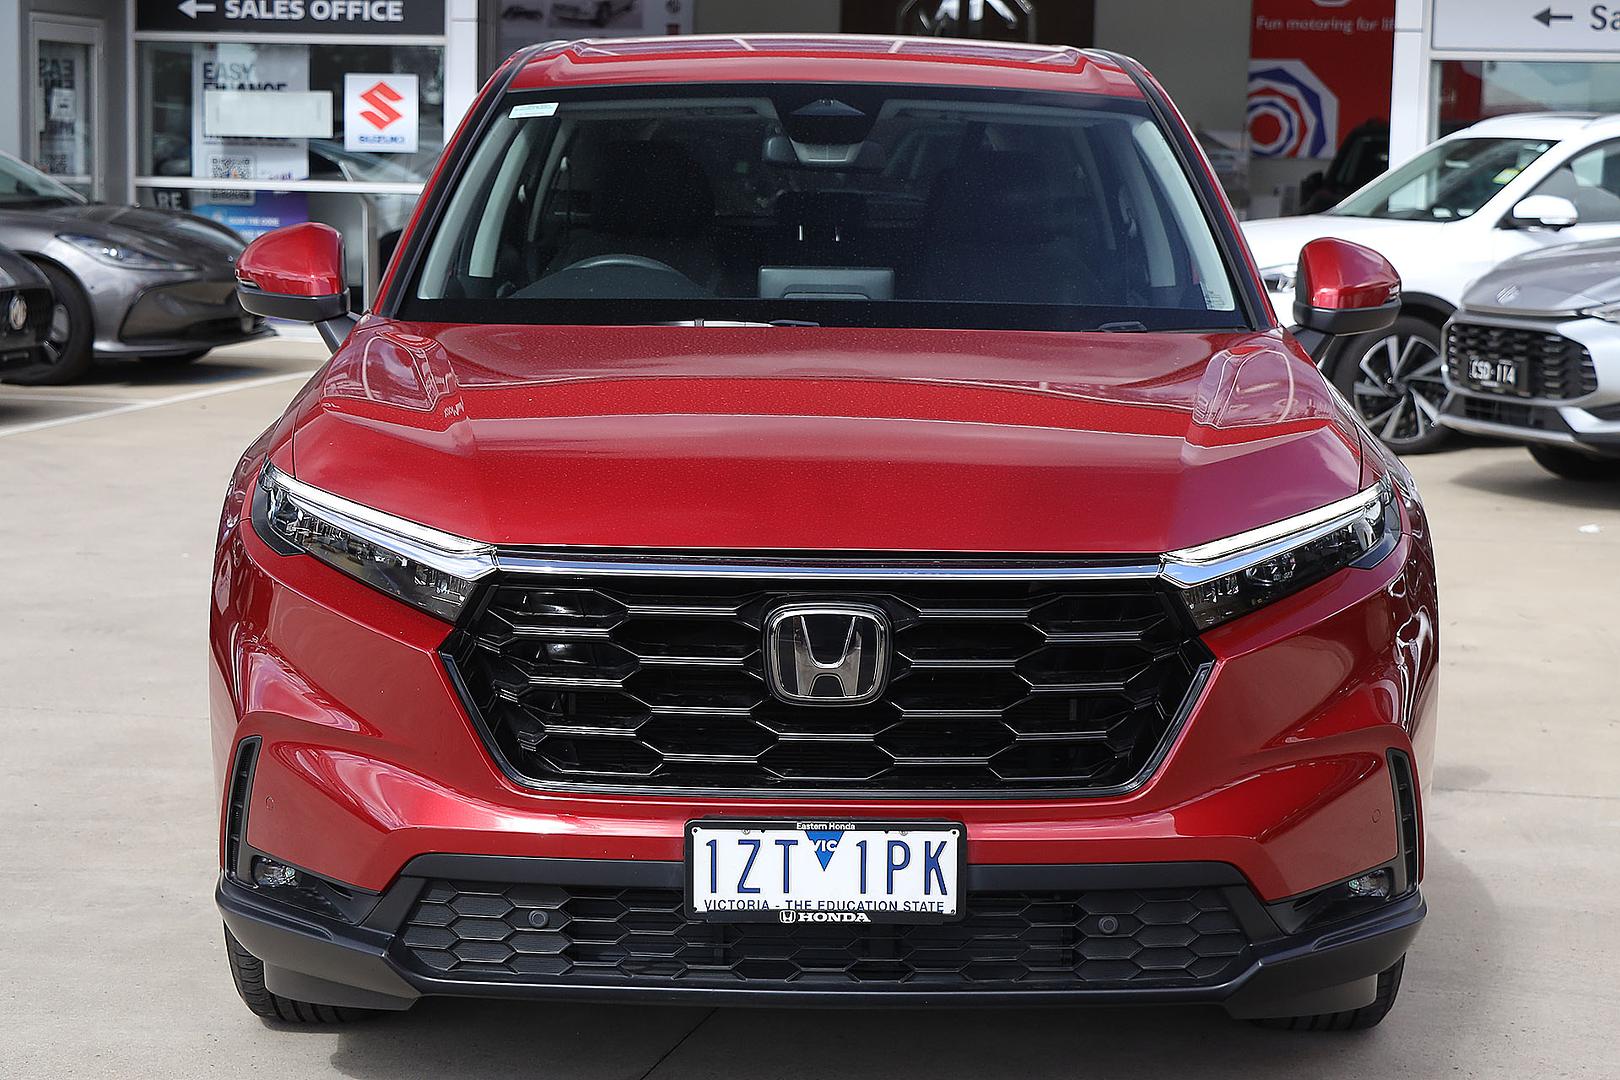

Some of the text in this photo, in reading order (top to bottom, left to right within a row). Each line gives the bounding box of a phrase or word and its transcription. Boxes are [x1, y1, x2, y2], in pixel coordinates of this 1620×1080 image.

[225, 0, 403, 21] SALES OFFICE
[1256, 16, 1281, 30] Fun
[1287, 16, 1352, 34] motoring
[1356, 17, 1377, 31] for
[204, 62, 256, 80] EASY
[796, 822, 856, 830] Eastern Honda
[811, 839, 838, 852] VIC
[706, 839, 798, 894] 1ZT
[856, 840, 948, 895] 1PK
[704, 899, 770, 912] VICTORIA
[785, 900, 812, 912] THE
[818, 900, 898, 913] EDUCATION
[903, 901, 945, 914] STATE
[798, 912, 872, 923] HONDA
